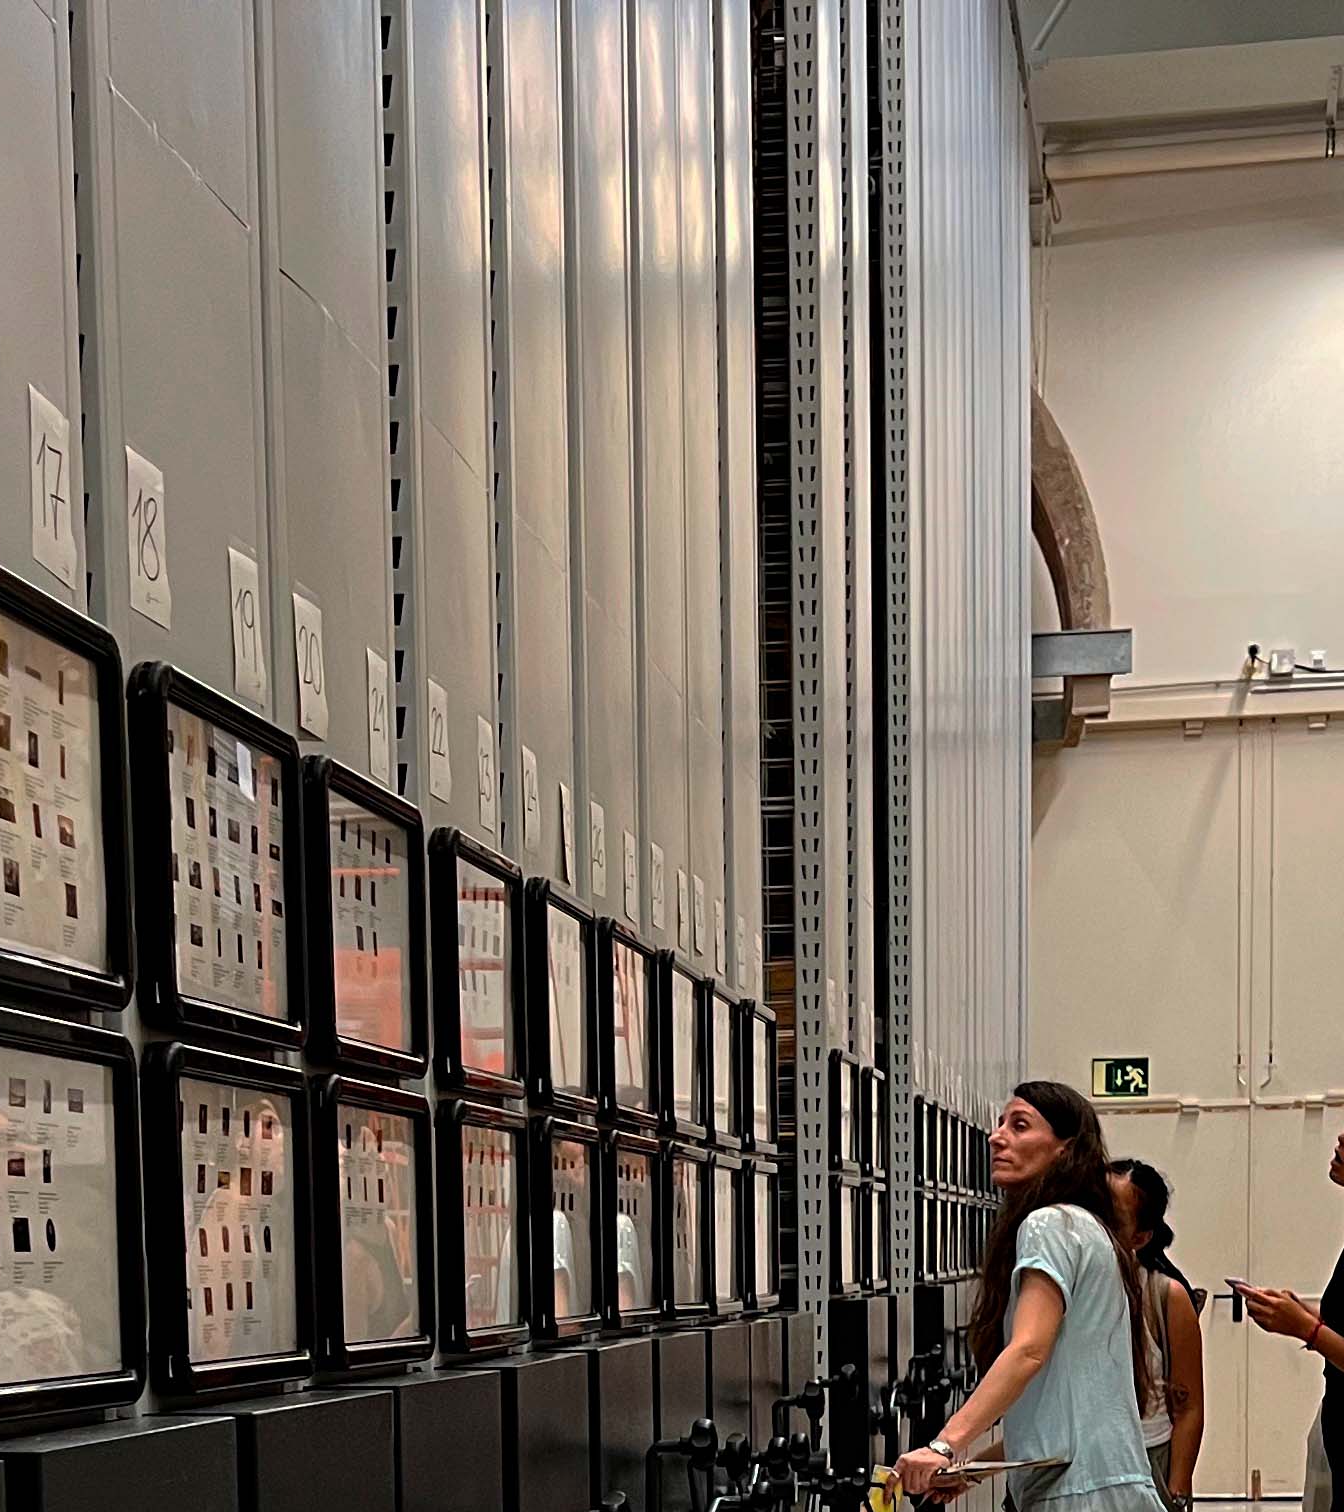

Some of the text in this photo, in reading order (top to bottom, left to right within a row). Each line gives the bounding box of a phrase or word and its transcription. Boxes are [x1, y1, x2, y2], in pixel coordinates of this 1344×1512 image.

[37, 432, 65, 540] 17
[132, 488, 160, 582] 18
[234, 588, 257, 674] 19
[298, 625, 322, 695] 20
[371, 687, 386, 742] 21
[431, 706, 446, 757] 22
[479, 746, 493, 802] 23
